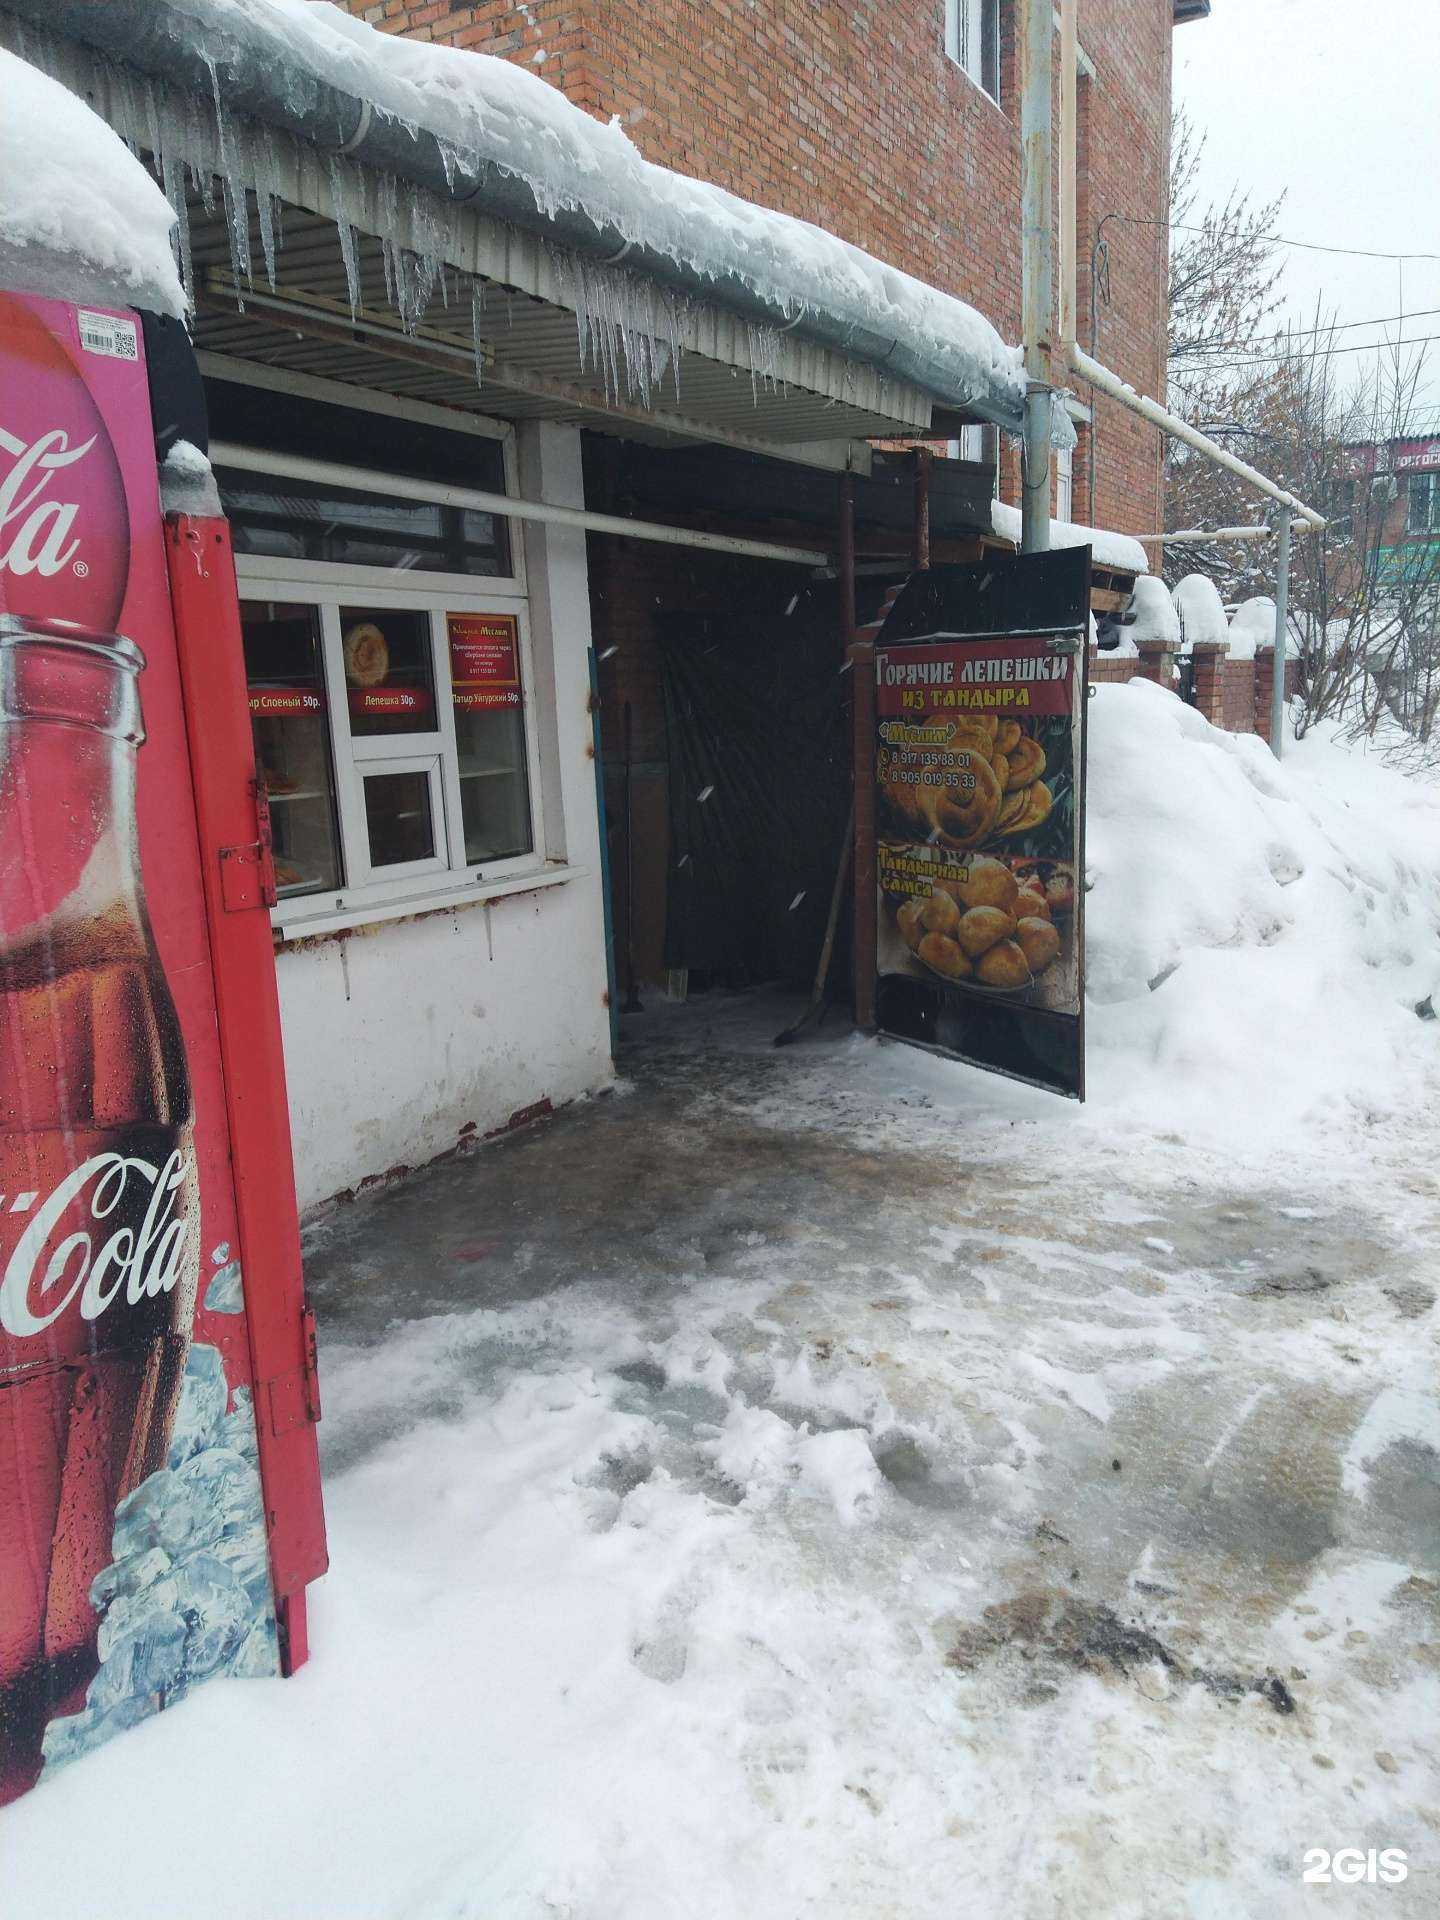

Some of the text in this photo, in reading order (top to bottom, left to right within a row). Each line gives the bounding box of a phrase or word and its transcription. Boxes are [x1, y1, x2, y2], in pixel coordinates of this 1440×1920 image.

[0, 428, 97, 577] la
[876, 653, 1068, 686] ГОРЯЧИЕ ЛЕПЕШКИ
[262, 695, 300, 707] Слоеный
[365, 695, 399, 706] Лепешка
[902, 687, 1031, 709] ИЗ ТАНДЫРА
[892, 751, 970, 766] 8 917 135 88 01
[892, 771, 975, 787] 8 905 019 35 33
